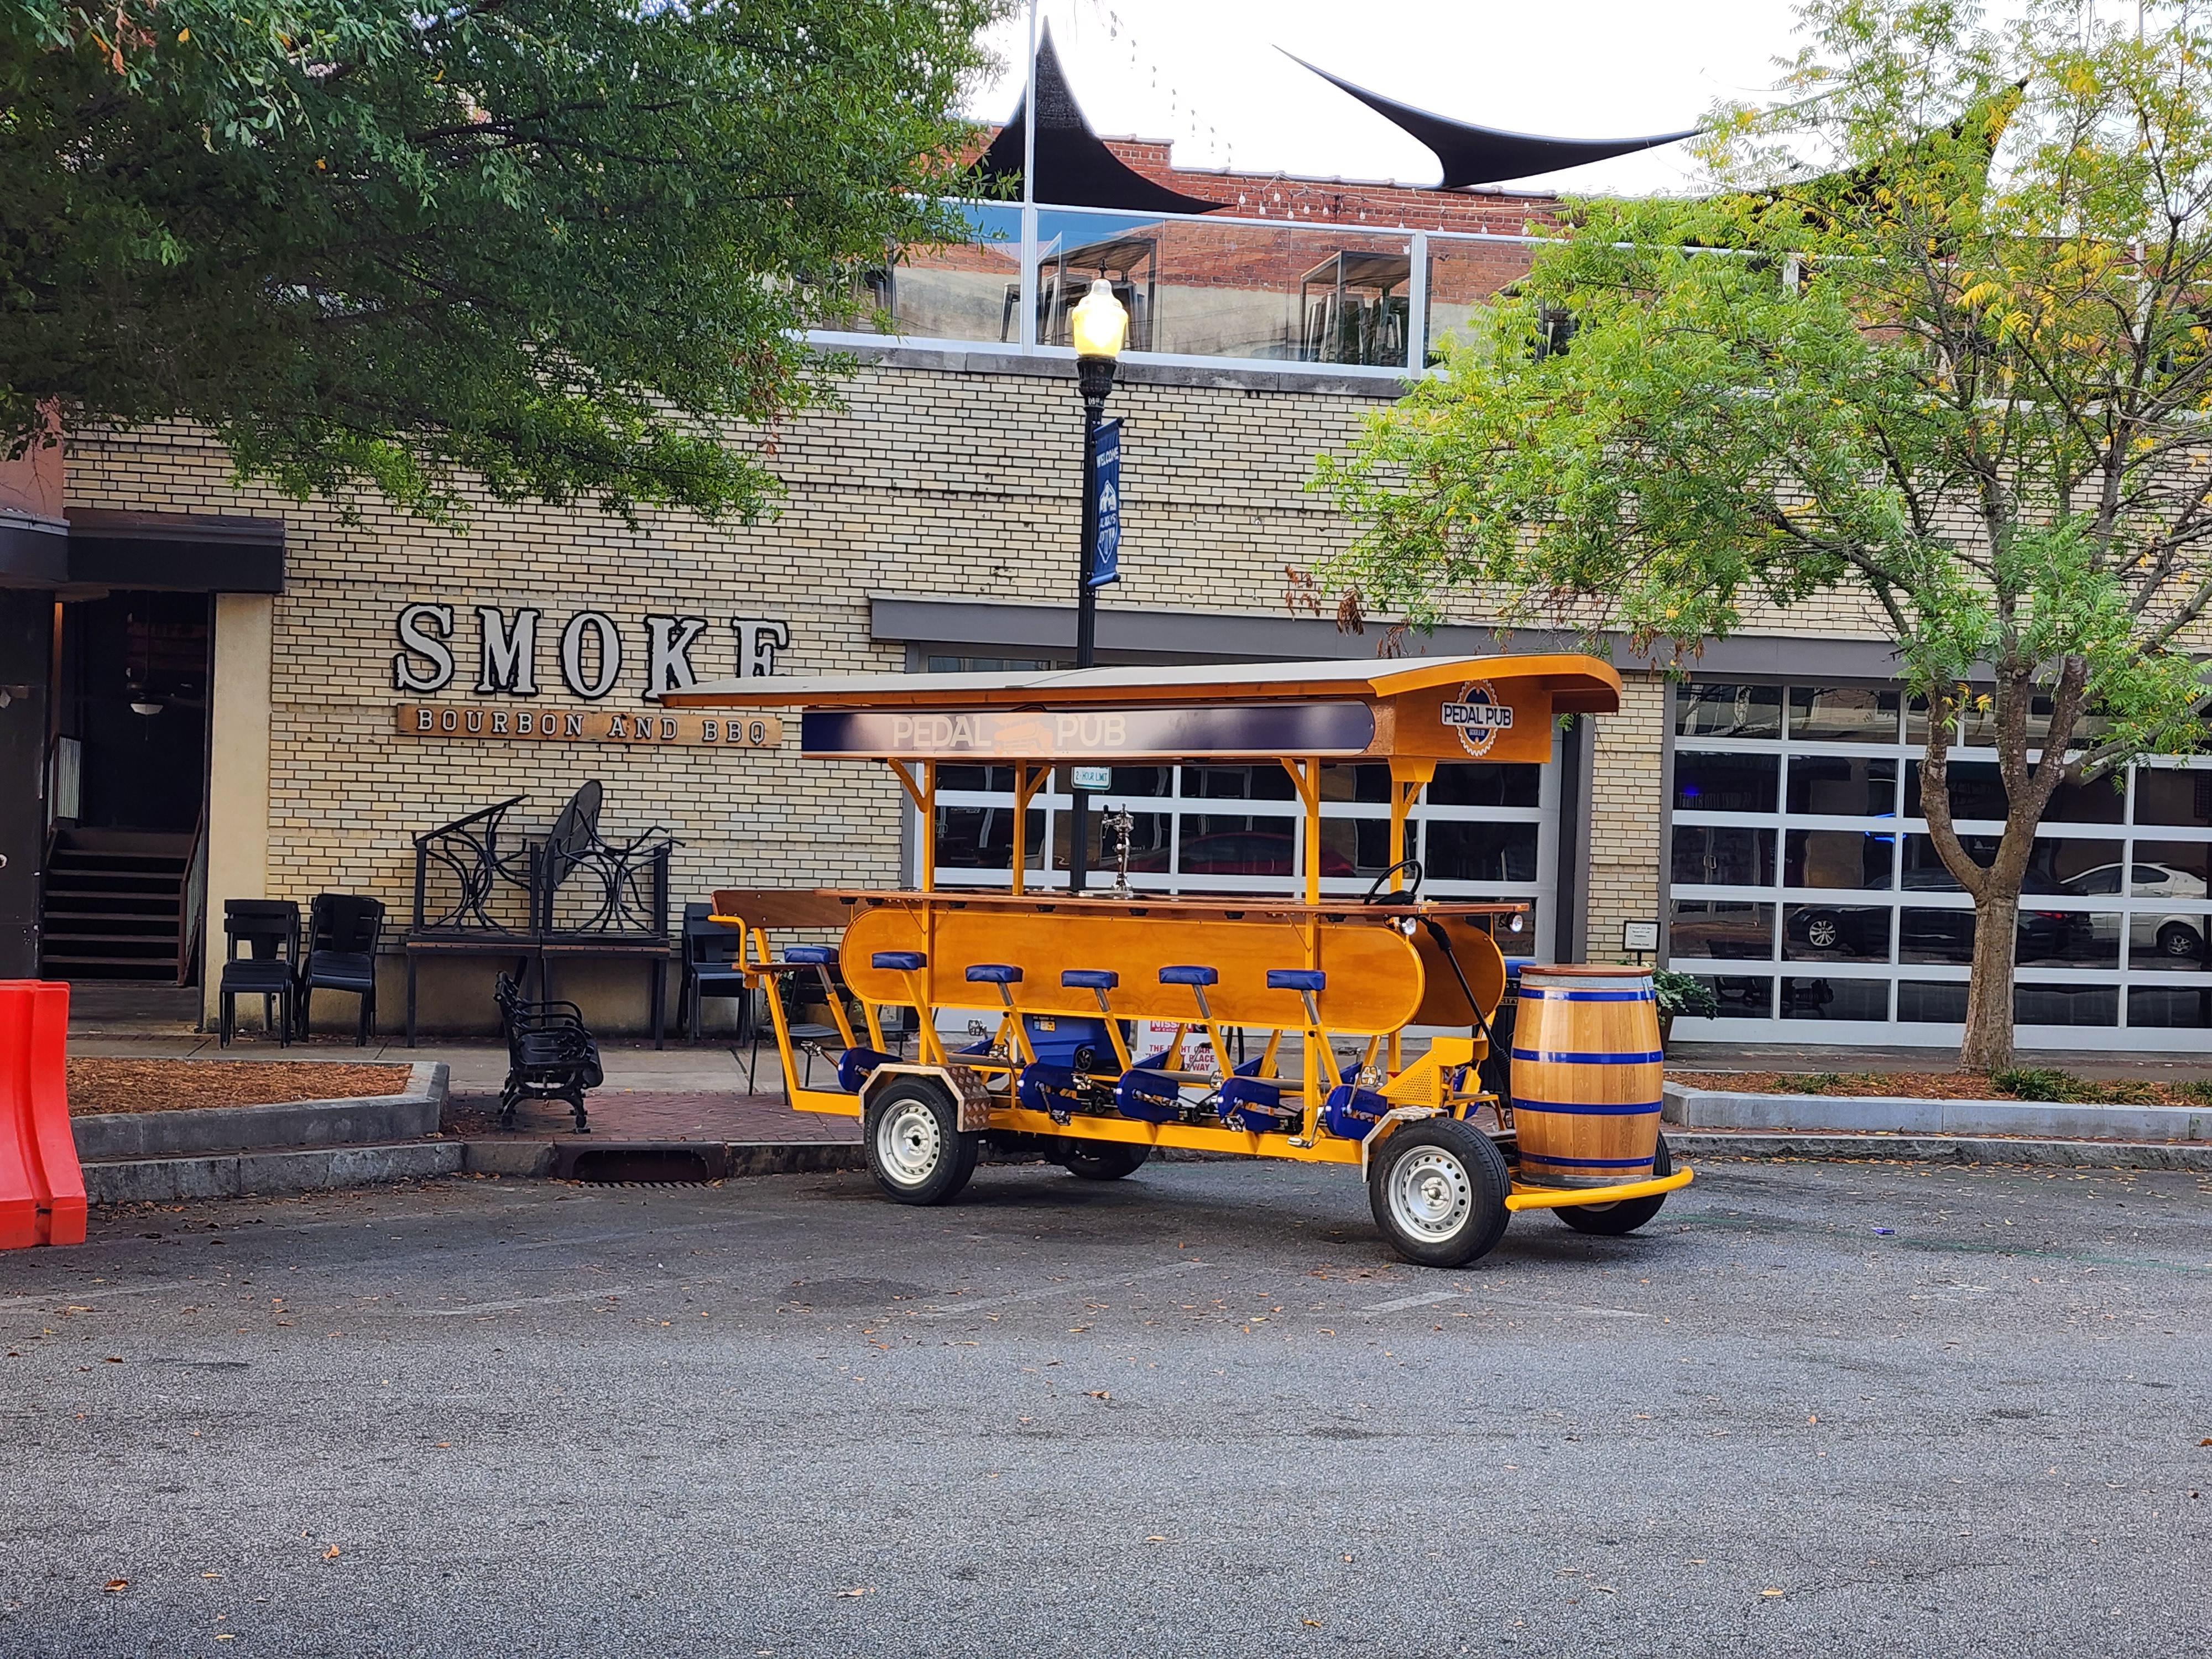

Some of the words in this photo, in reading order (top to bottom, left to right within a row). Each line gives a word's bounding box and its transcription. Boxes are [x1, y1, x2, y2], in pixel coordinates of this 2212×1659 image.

[393, 603, 789, 702] SMOKE
[417, 708, 584, 738] BOURBON
[609, 714, 678, 740] AND
[703, 719, 767, 745] BBQ
[1443, 705, 1484, 724] PEDAL
[1485, 707, 1512, 726] PUB
[892, 716, 993, 747] PEDAL
[1057, 713, 1128, 747] PUB
[1189, 1054, 1215, 1063] PLACE
[1193, 1063, 1211, 1071] WAY
